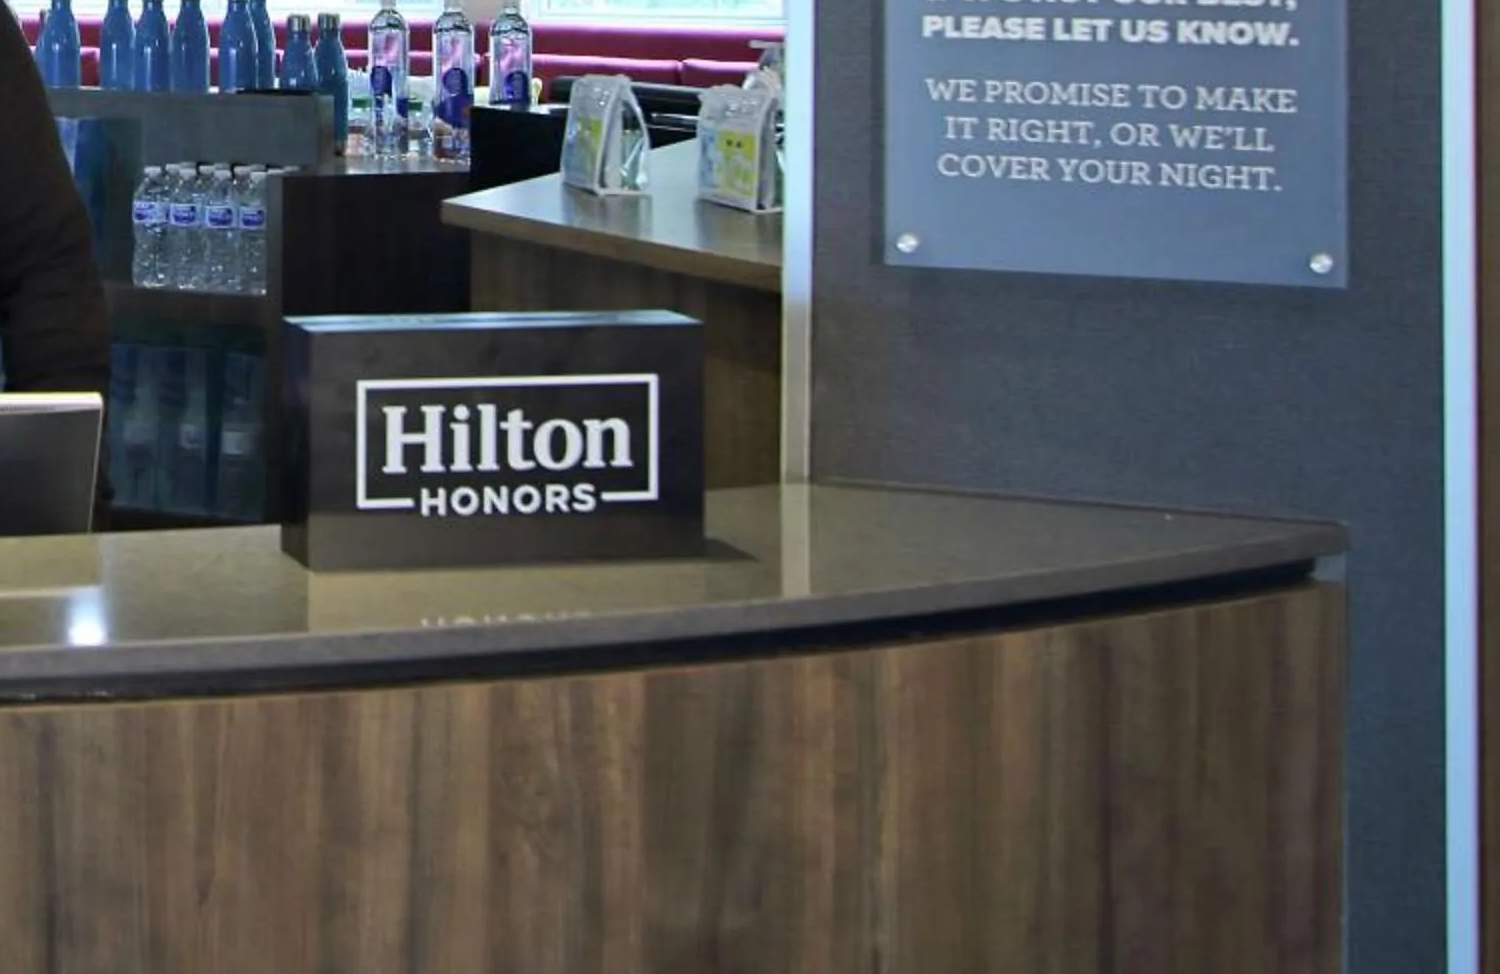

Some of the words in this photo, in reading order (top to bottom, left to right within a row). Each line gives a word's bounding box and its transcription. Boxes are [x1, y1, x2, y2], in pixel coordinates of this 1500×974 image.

[922, 16, 1046, 41] PLEASE
[1053, 19, 1113, 42] LET
[1120, 20, 1169, 43] US
[1177, 21, 1300, 47] KNOW.
[925, 78, 975, 103] WE
[984, 80, 1131, 107] PROMISE
[1138, 85, 1186, 108] TO
[1194, 88, 1298, 113] MAKE
[944, 116, 979, 140] IT
[987, 118, 1101, 147] RIGHT,
[1109, 122, 1161, 147] OR
[1169, 124, 1274, 152] WE'LL
[937, 154, 1050, 181] COVER
[1057, 157, 1152, 185] YOUR
[1159, 162, 1282, 192] NIGHT.
[382, 403, 633, 473] Hilton
[420, 483, 596, 516] HONORS
